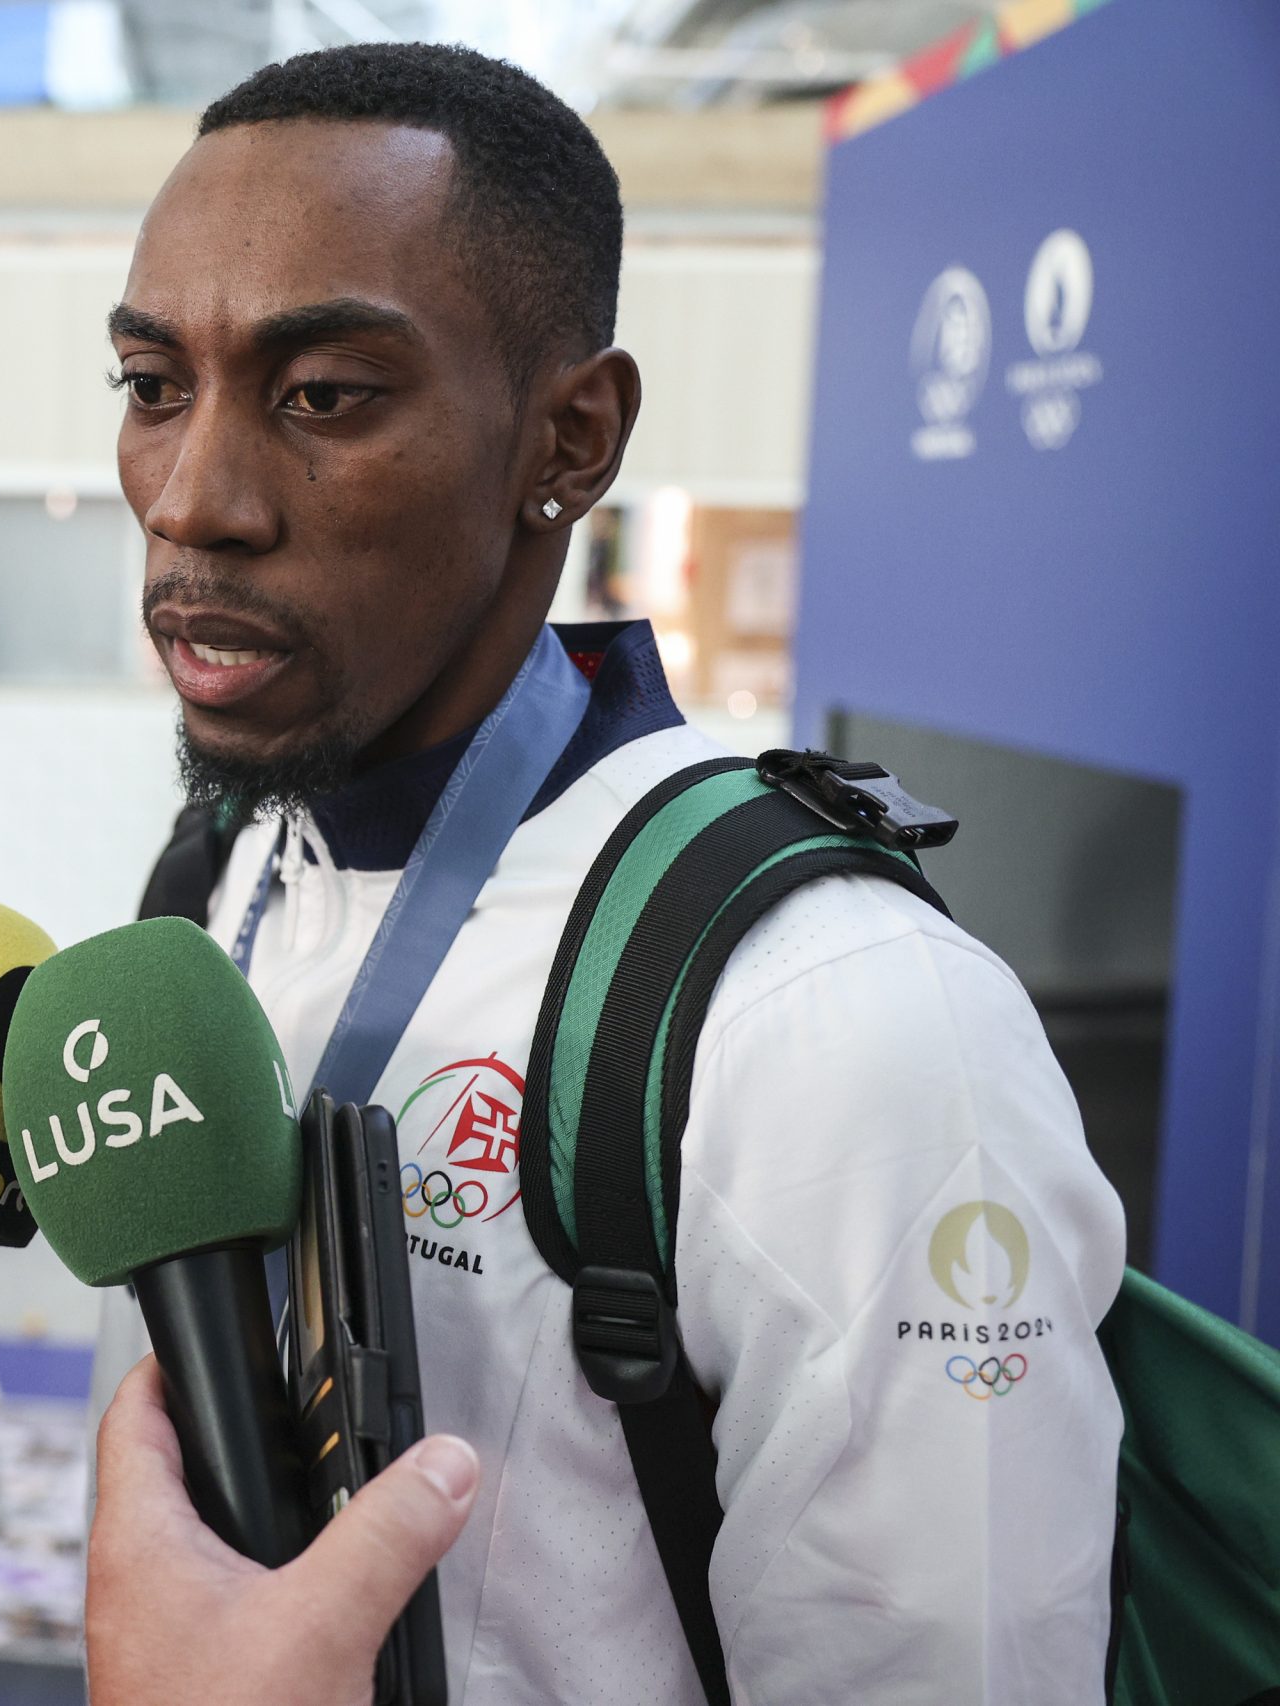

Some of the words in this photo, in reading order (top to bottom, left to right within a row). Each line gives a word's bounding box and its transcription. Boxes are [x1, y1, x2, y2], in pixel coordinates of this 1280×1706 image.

[22, 1073, 205, 1184] LUSA
[404, 1233, 484, 1276] TUGAL
[998, 1315, 1054, 1342] 2024
